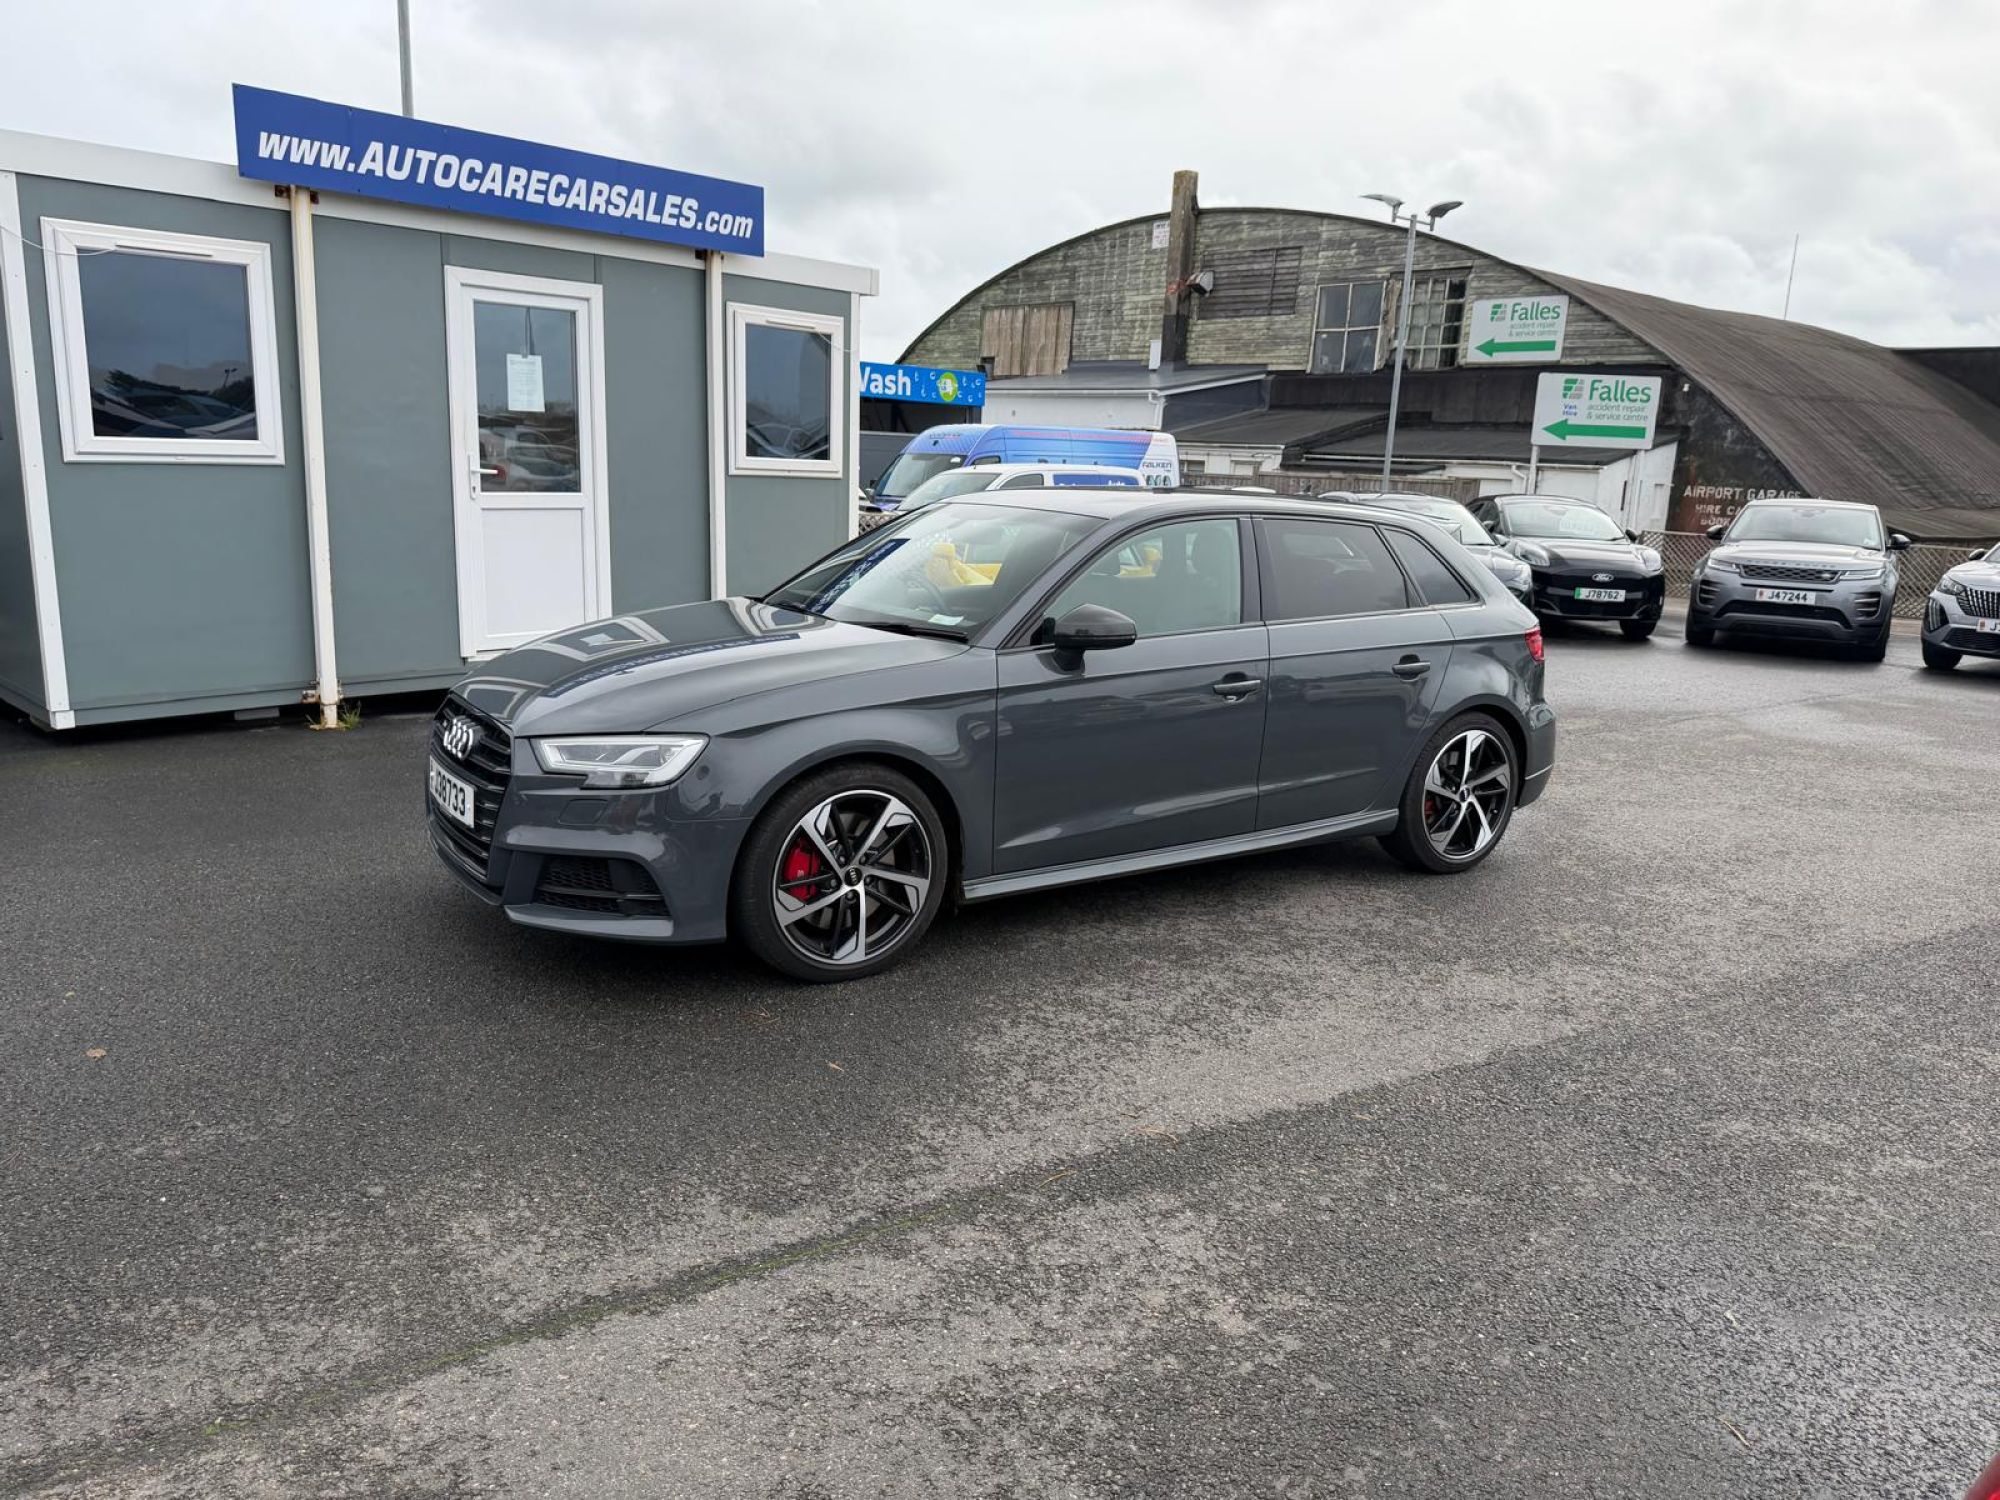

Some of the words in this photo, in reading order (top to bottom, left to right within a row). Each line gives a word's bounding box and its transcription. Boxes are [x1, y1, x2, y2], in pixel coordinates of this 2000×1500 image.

[258, 130, 754, 239] www.AUTOCARECARSALES.com
[1510, 301, 1561, 321] Falles
[1589, 379, 1652, 403] Falles
[1587, 403, 1621, 412] accident
[1622, 404, 1646, 413] repair
[1595, 412, 1621, 421] service
[1623, 413, 1649, 421] centre
[1683, 485, 1744, 500] AIRPORT
[1695, 504, 1723, 515] HIRE
[1584, 589, 1619, 601] J78762
[1767, 590, 1808, 602] J47244
